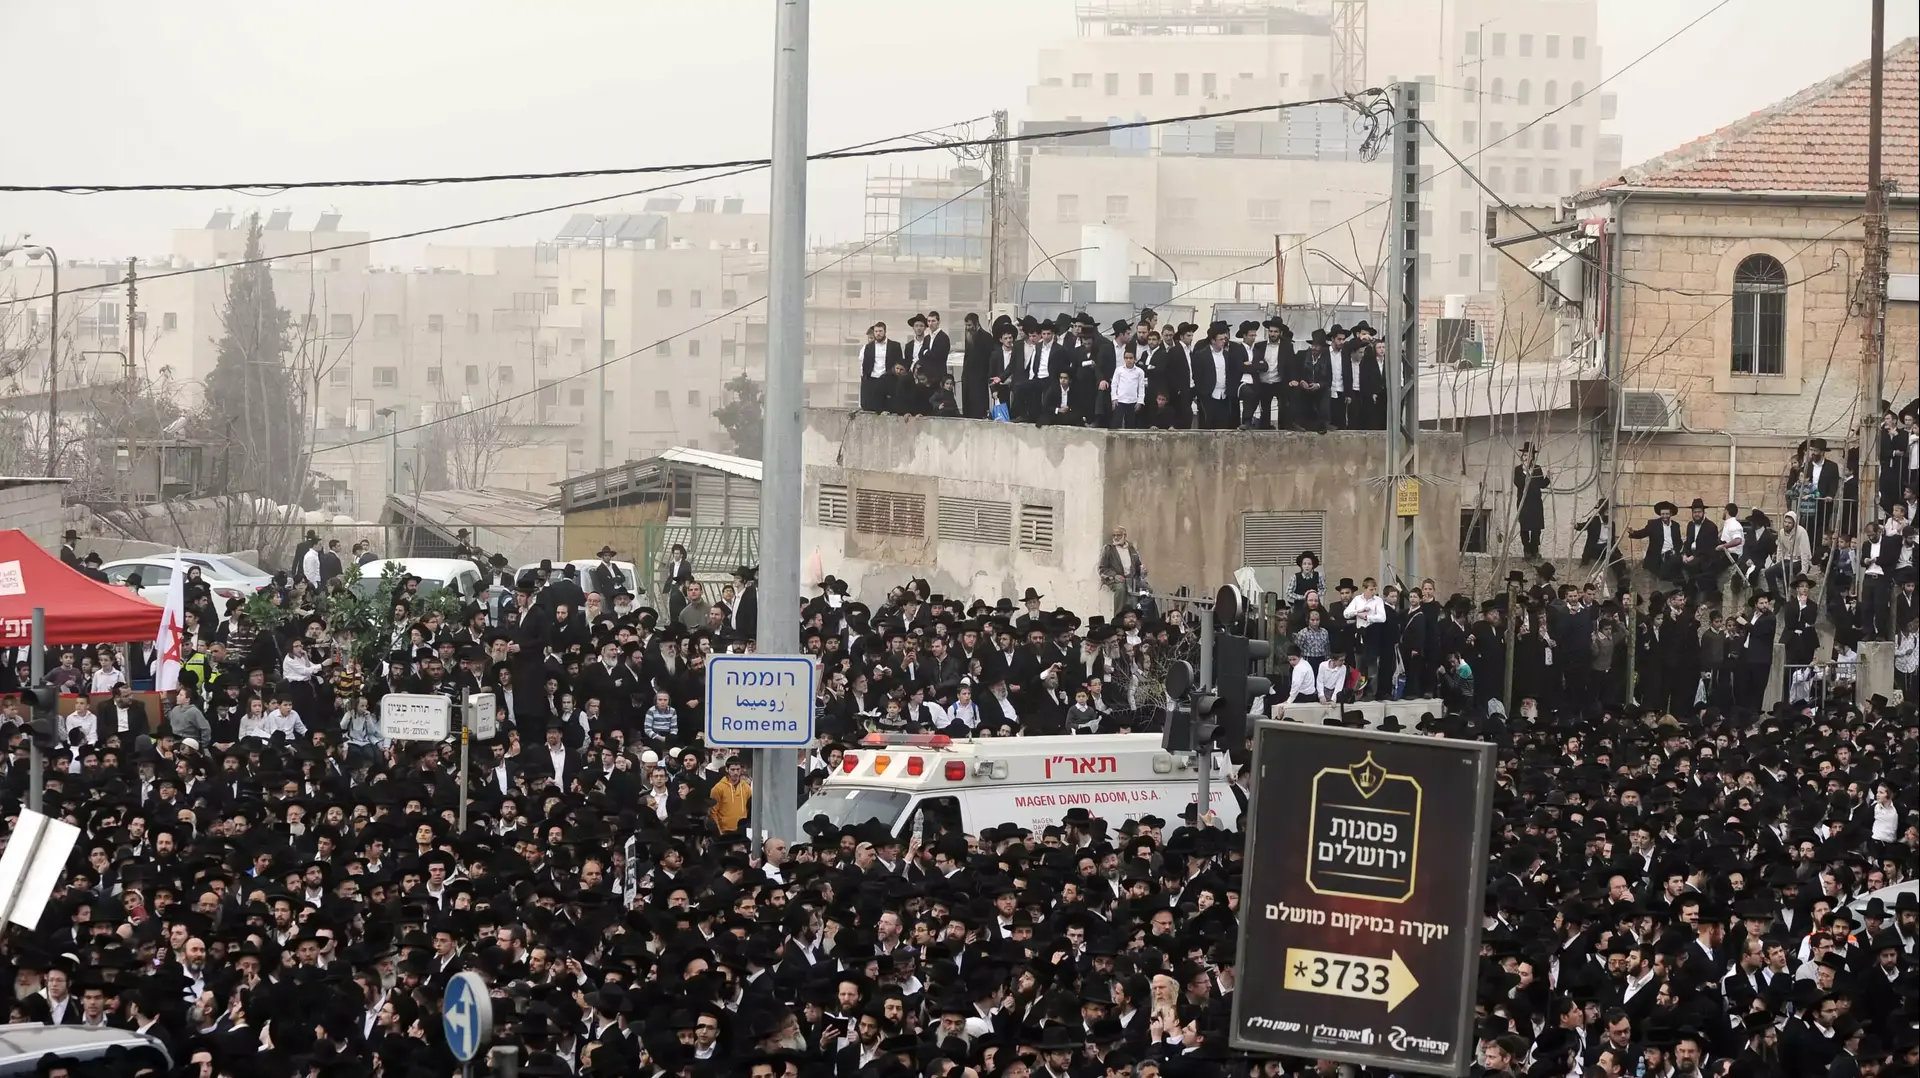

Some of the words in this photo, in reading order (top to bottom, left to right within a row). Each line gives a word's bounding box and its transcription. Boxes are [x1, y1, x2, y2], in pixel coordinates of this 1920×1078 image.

[727, 671, 795, 686] רוממה
[736, 695, 784, 712] روميما
[722, 716, 797, 731] Romema
[1044, 756, 1117, 779] תאר"ן
[1015, 793, 1056, 807] MAGEN
[1058, 793, 1091, 805] DAVID
[1094, 792, 1130, 804] ADOM,
[1131, 790, 1161, 801] U.S.A.
[1329, 817, 1398, 843] פסגות
[1318, 838, 1406, 869] ירושלים
[1265, 902, 1326, 925] מושלם
[1330, 911, 1395, 935] במיקום
[1400, 919, 1449, 944] יוקרה
[1338, 1028, 1361, 1041] אקה
